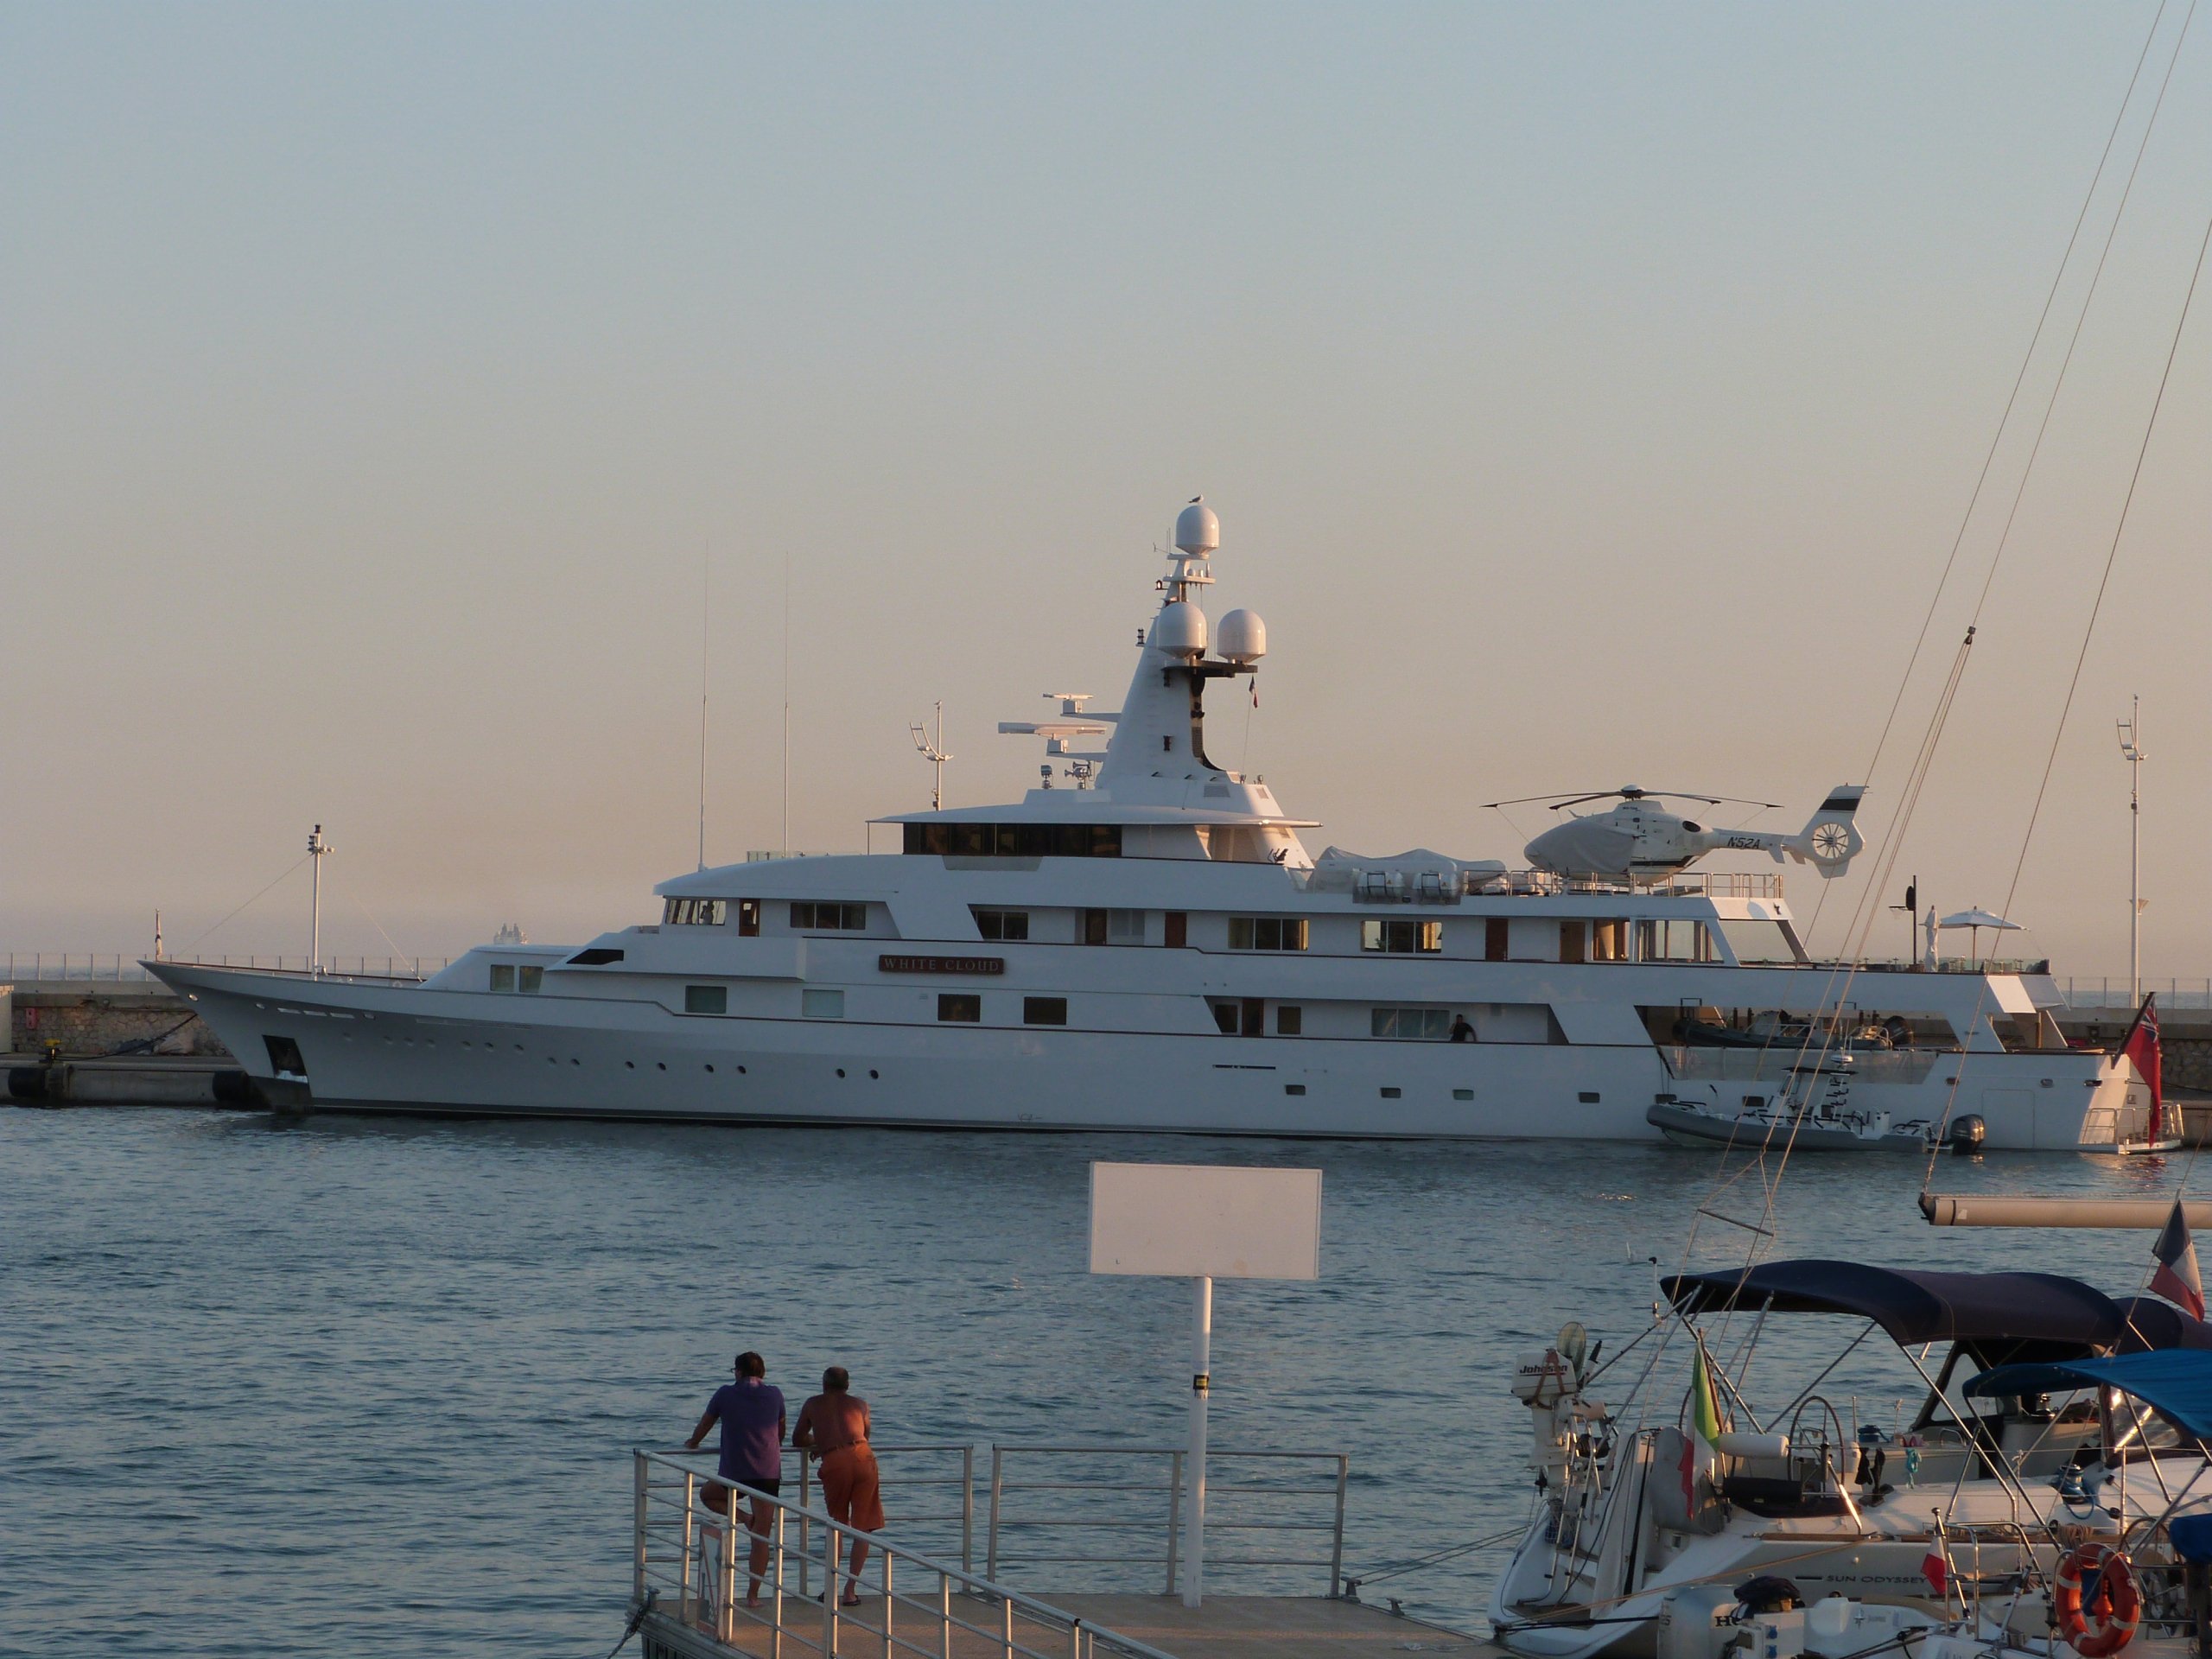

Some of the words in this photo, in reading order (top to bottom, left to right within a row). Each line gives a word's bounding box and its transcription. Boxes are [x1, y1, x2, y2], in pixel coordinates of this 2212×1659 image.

[1727, 836, 1761, 849] N52A
[884, 957, 936, 969] WHITE
[945, 959, 999, 971] CLOUD
[1861, 1575, 1928, 1584] ODYSSEY
